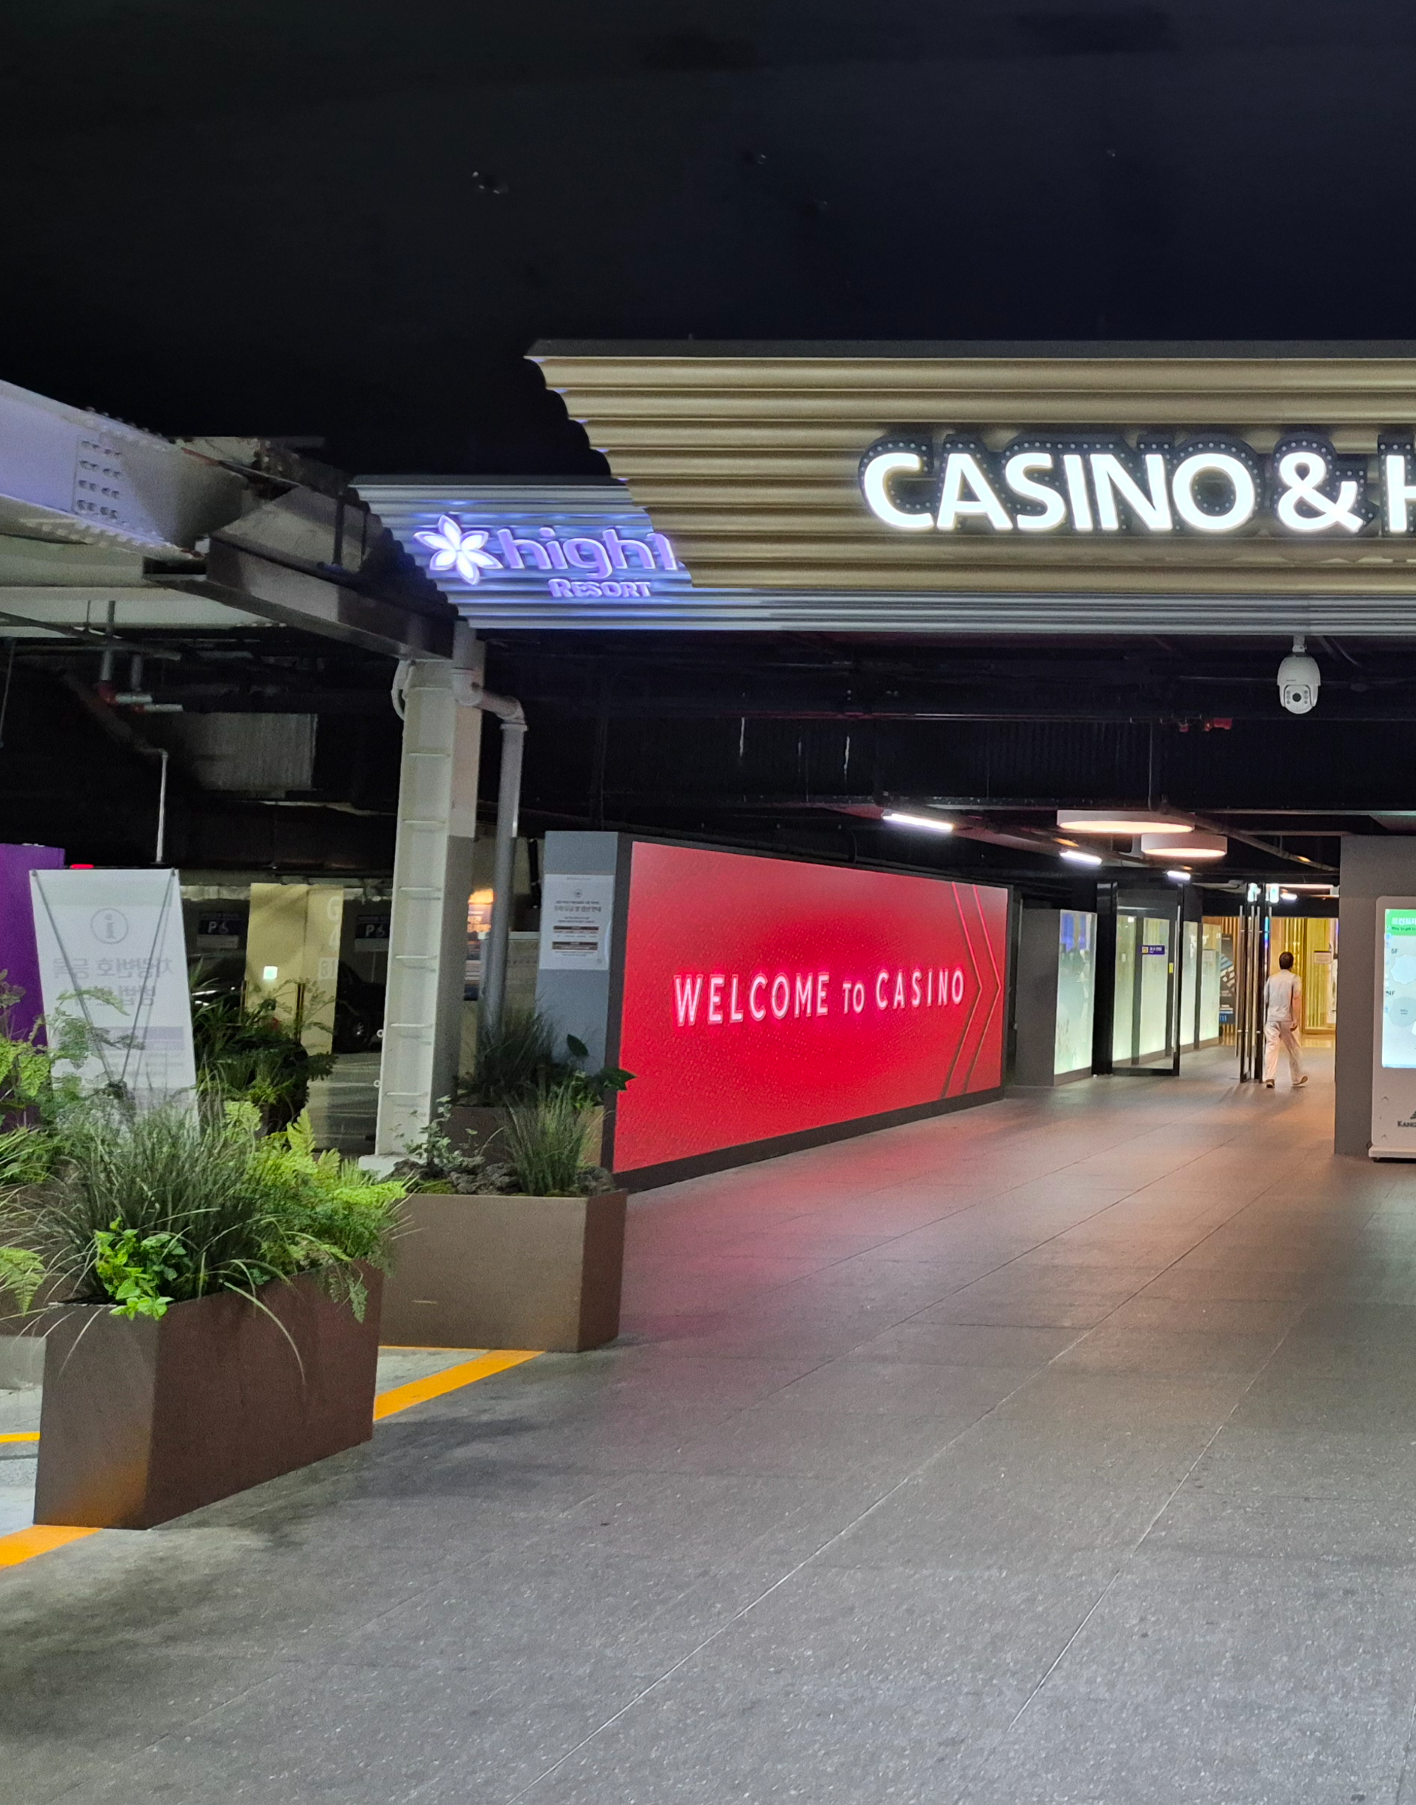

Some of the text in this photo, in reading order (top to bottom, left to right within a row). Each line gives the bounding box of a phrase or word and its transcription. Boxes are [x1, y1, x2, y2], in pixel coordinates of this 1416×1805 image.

[862, 451, 1256, 533] CASINO
[1276, 450, 1365, 534] &
[548, 578, 651, 598] RESORT
[674, 972, 830, 1027] WELCOME
[875, 967, 964, 1011] CASINO
